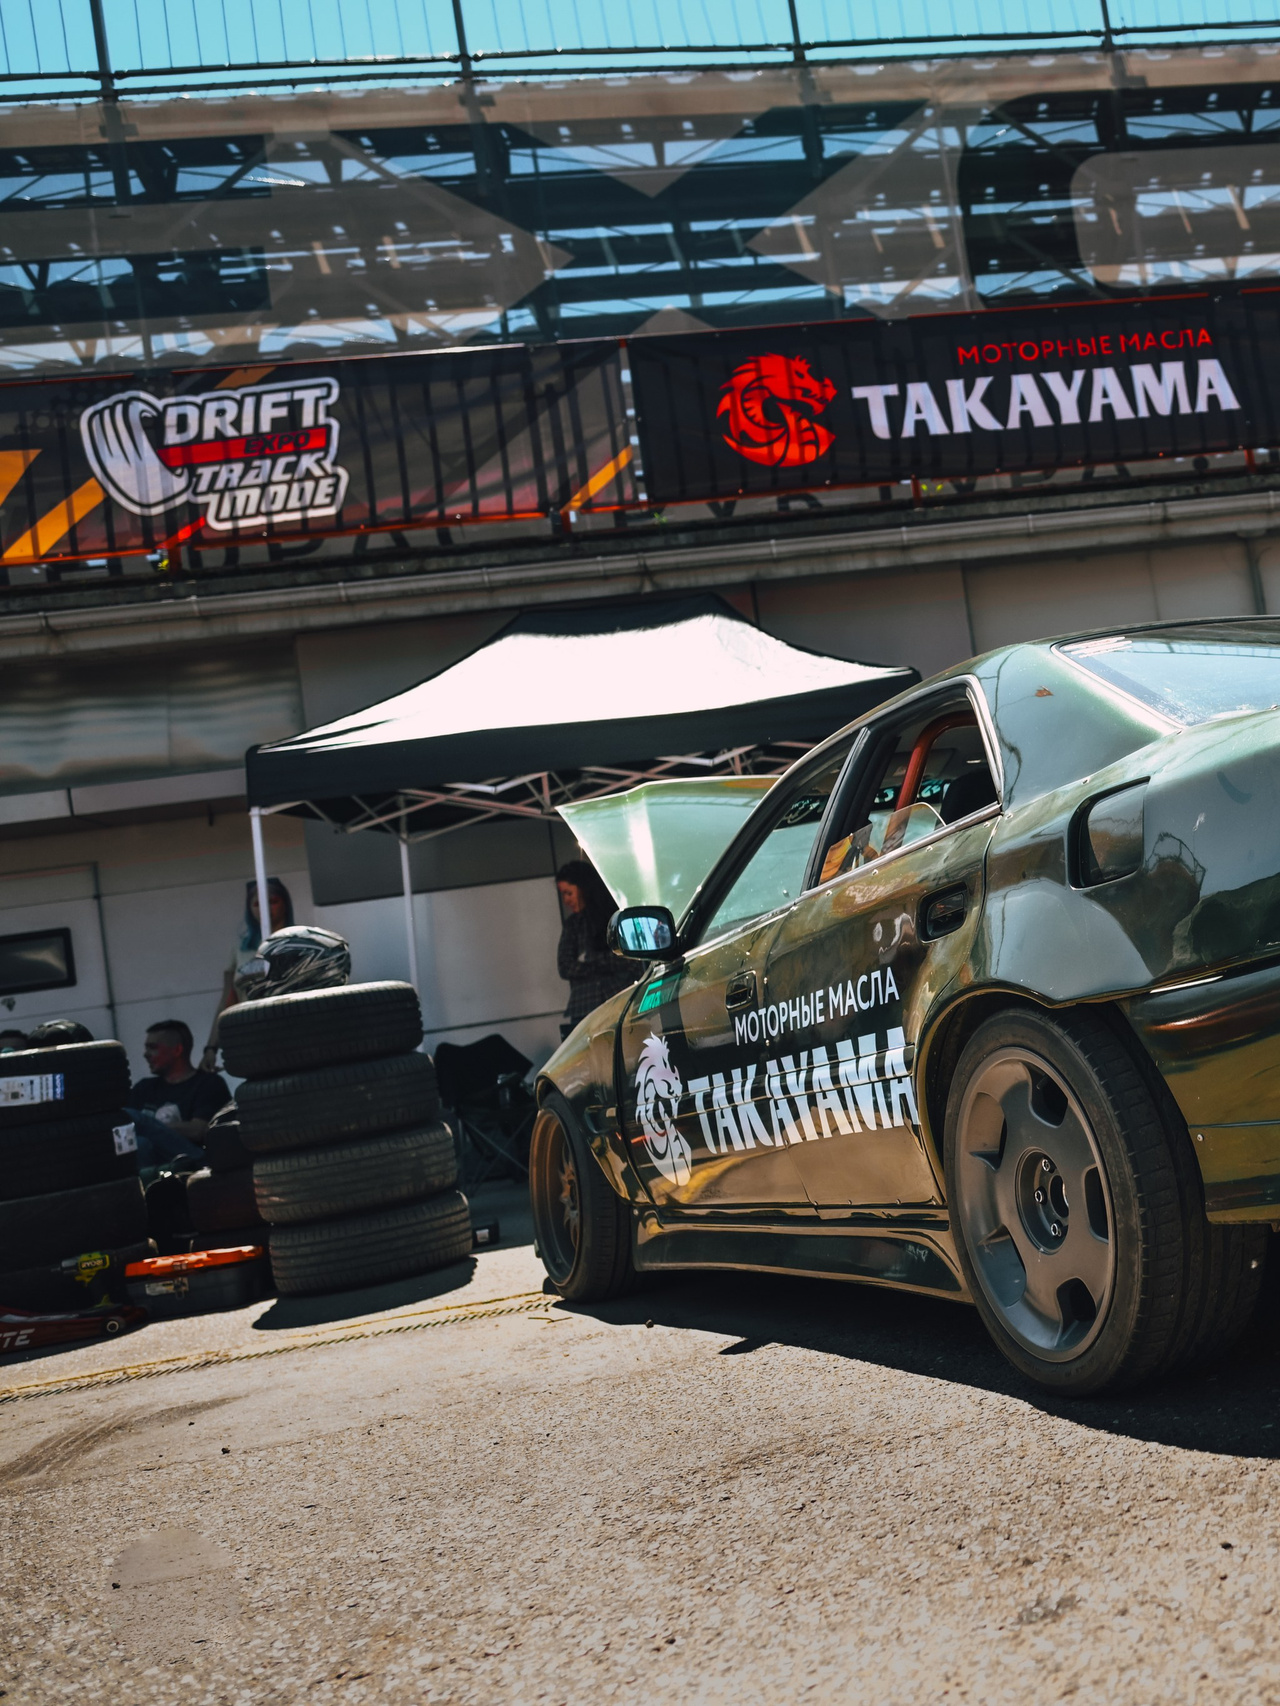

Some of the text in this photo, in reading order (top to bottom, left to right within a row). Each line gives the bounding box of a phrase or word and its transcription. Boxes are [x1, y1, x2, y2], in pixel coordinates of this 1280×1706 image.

[956, 327, 1214, 366] МОТОРНЫЕ МАСЛА
[163, 386, 328, 446] DRIFT
[851, 358, 1242, 440] TAKAYAMA
[243, 431, 311, 455] EXPO
[734, 988, 825, 1047] МОТОРНЫЕ
[828, 966, 900, 1020] МАСЛА
[687, 1026, 922, 1155] TAKAYAMA
